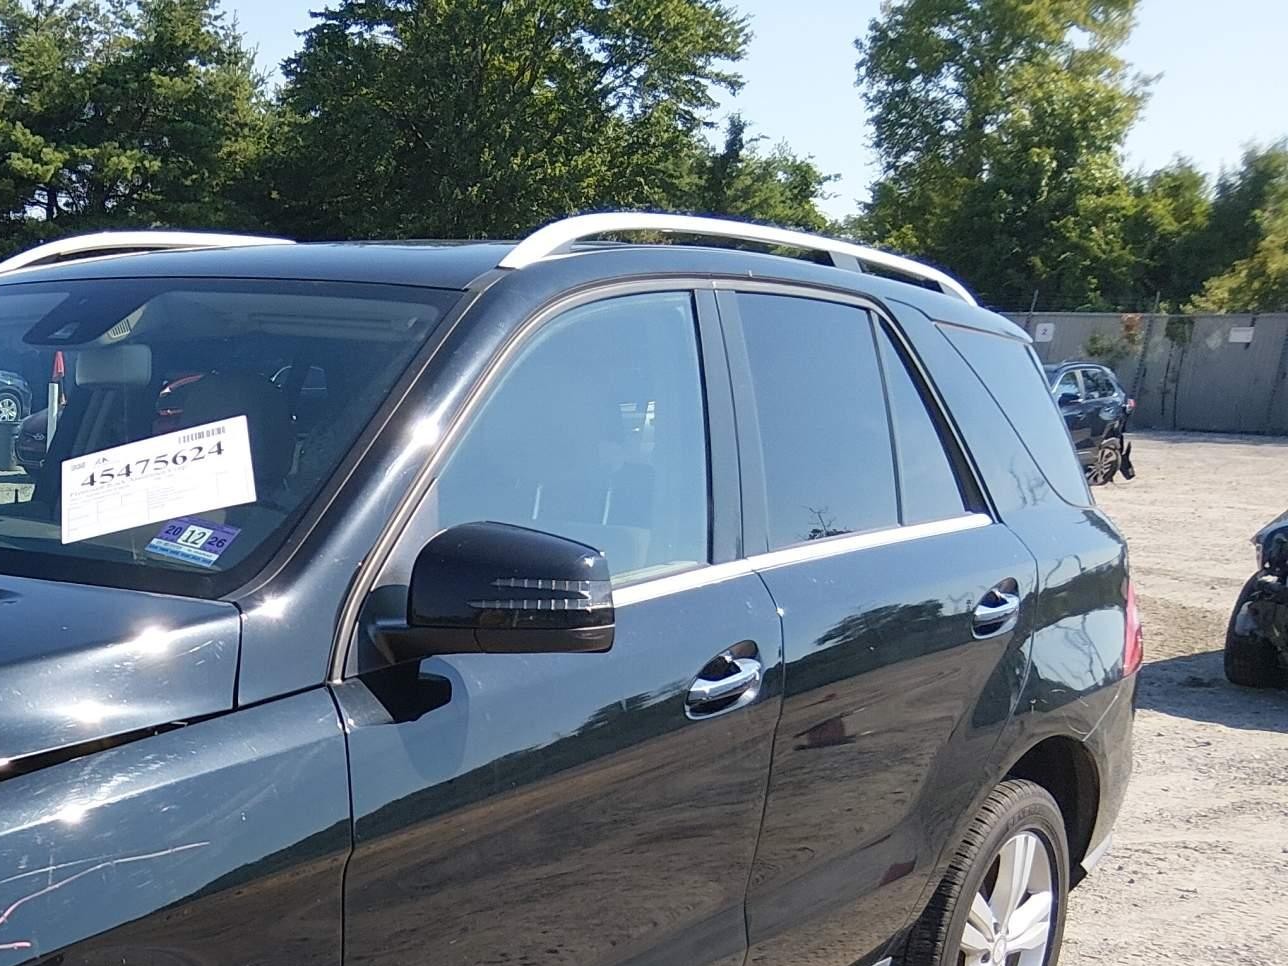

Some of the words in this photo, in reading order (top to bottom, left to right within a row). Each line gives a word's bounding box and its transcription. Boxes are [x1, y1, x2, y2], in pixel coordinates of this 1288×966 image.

[80, 440, 225, 488] 45475624
[164, 524, 183, 536] 20
[182, 528, 206, 545] 12
[207, 536, 227, 548] 26
